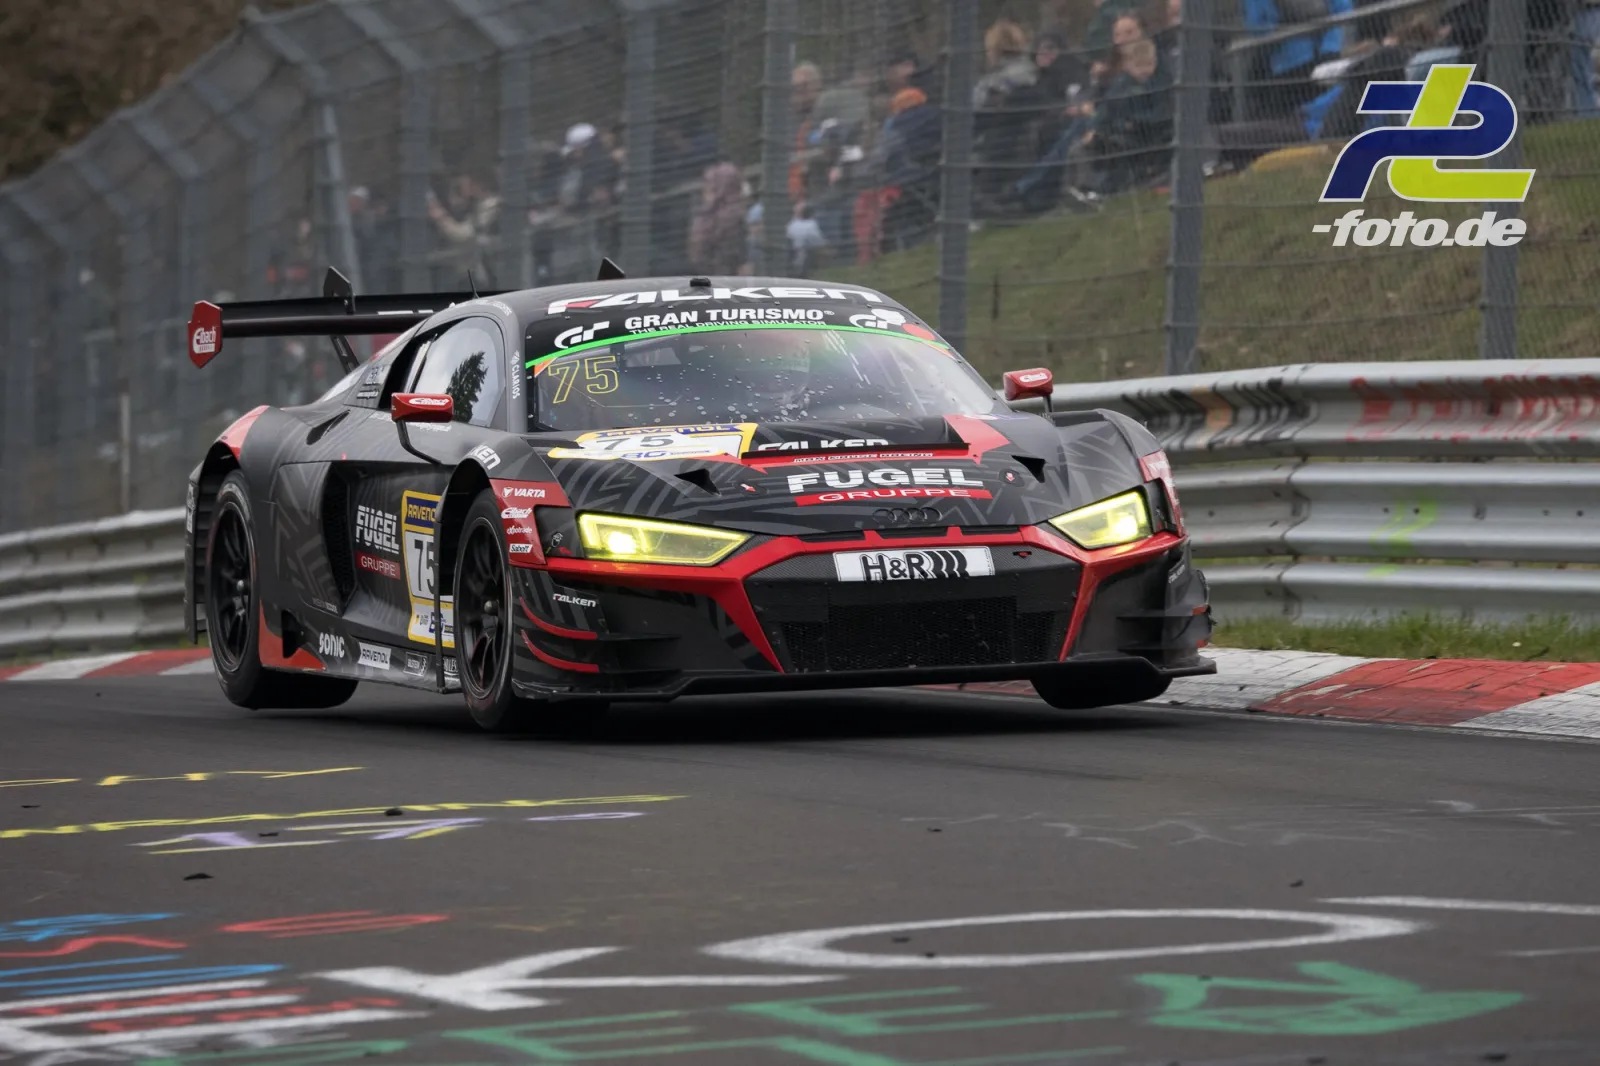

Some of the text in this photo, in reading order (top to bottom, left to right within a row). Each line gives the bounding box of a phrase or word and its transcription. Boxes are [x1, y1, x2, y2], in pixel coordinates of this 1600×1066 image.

[548, 287, 883, 315] FALKEN
[624, 310, 699, 330] GRAN
[512, 364, 521, 400] CLARIOS
[547, 356, 619, 404] 75
[596, 434, 674, 451] 75
[787, 468, 984, 494] FUGEL
[514, 488, 546, 498] VARTA
[818, 489, 971, 502] GRUPPE
[356, 505, 400, 555] FUGEL
[361, 556, 396, 577] GRUPPE
[553, 593, 597, 607] FALKEN
[362, 648, 389, 664] RAVENOL
